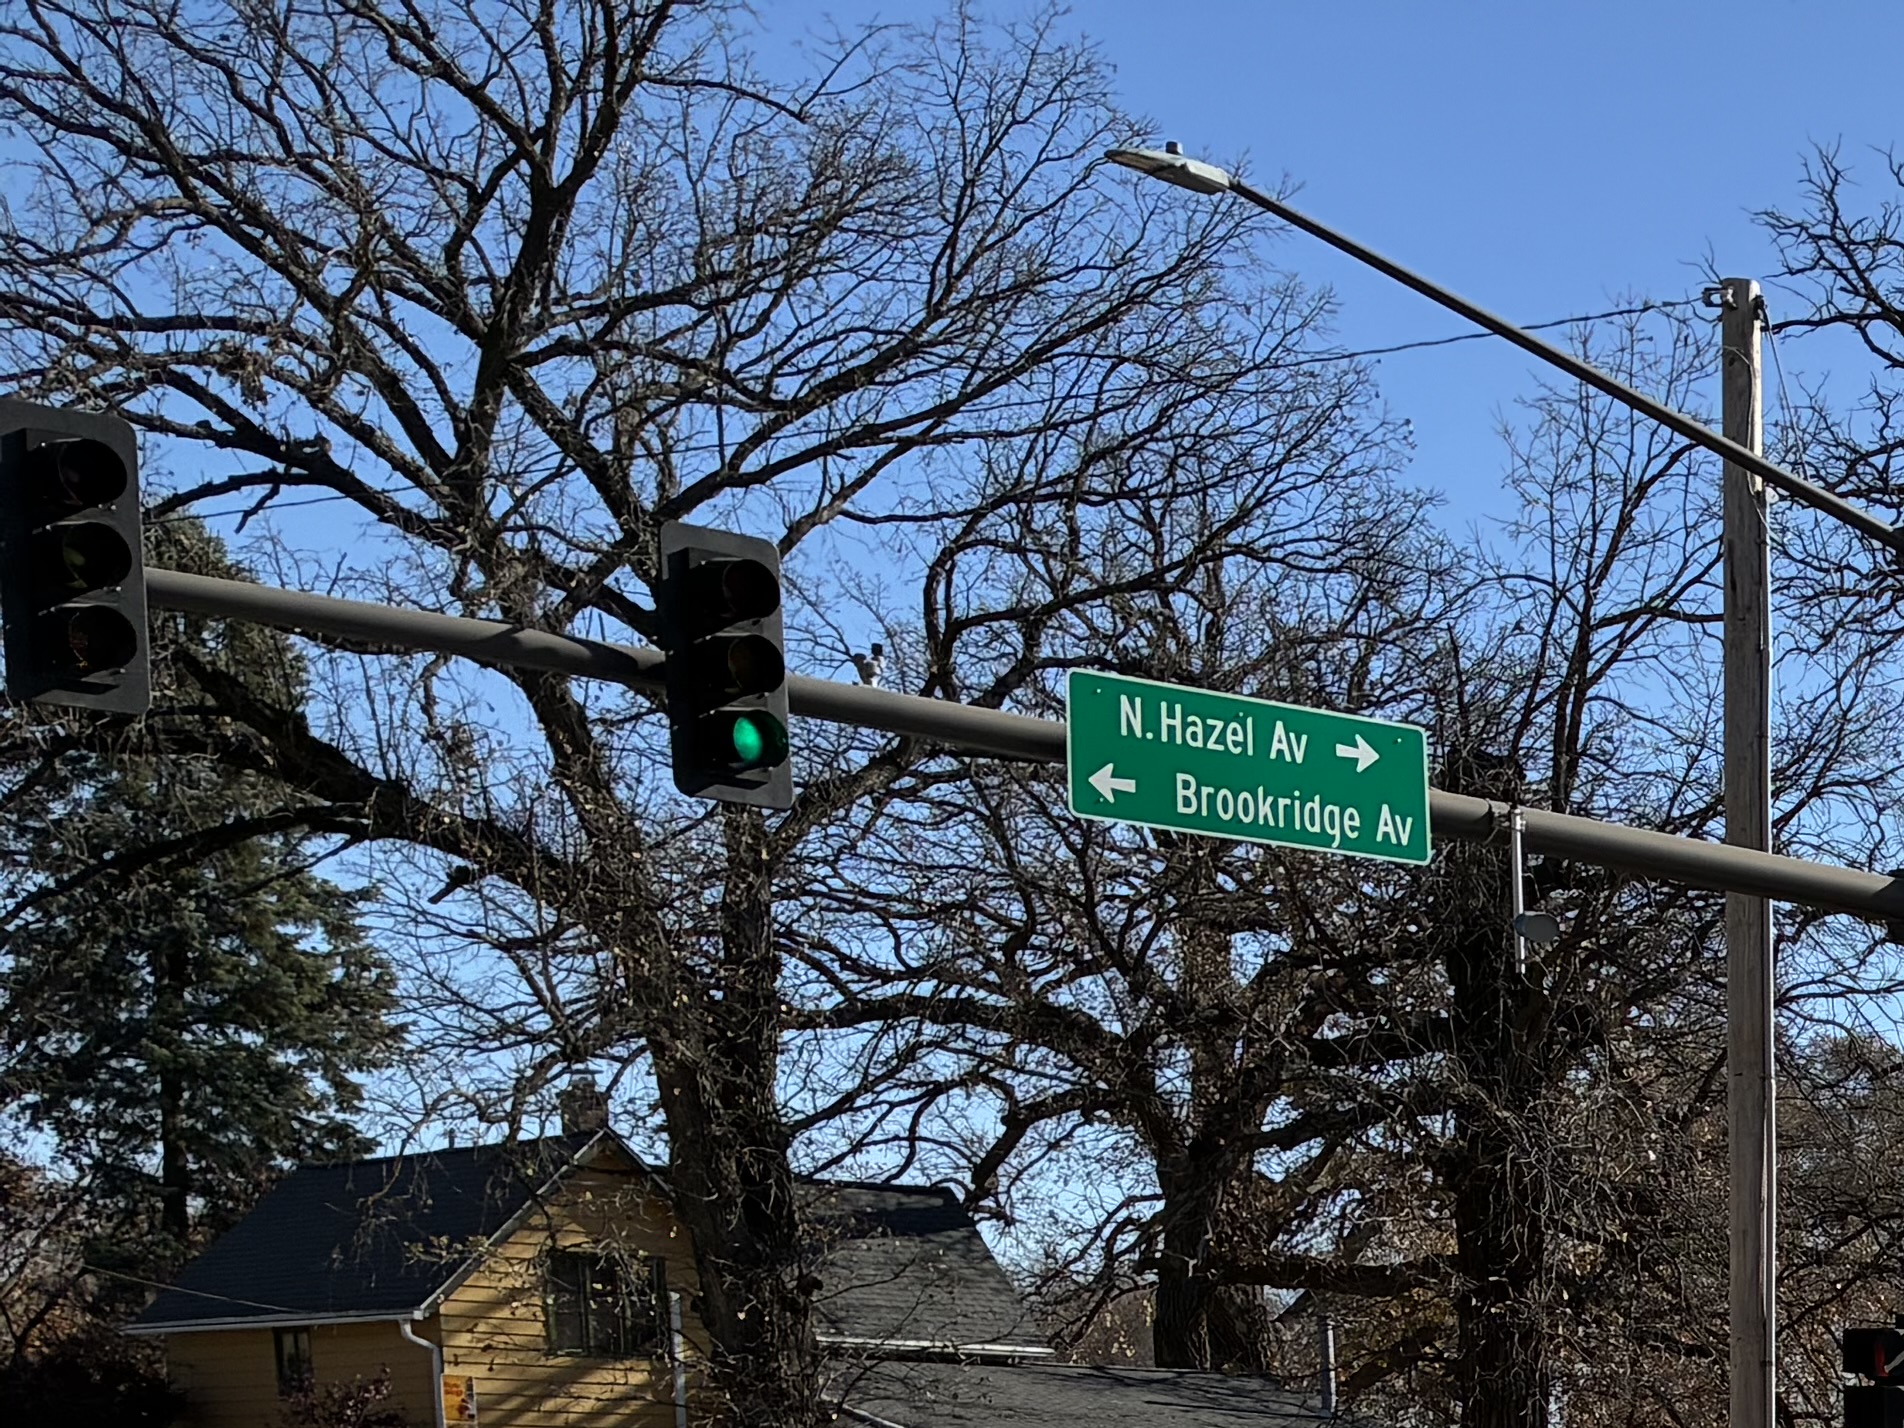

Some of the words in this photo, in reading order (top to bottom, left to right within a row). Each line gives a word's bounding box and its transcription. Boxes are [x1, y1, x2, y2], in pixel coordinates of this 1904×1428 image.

[1269, 720, 1308, 764] Av
[1176, 772, 1361, 848] Brookridge
[1376, 803, 1413, 846] Av
